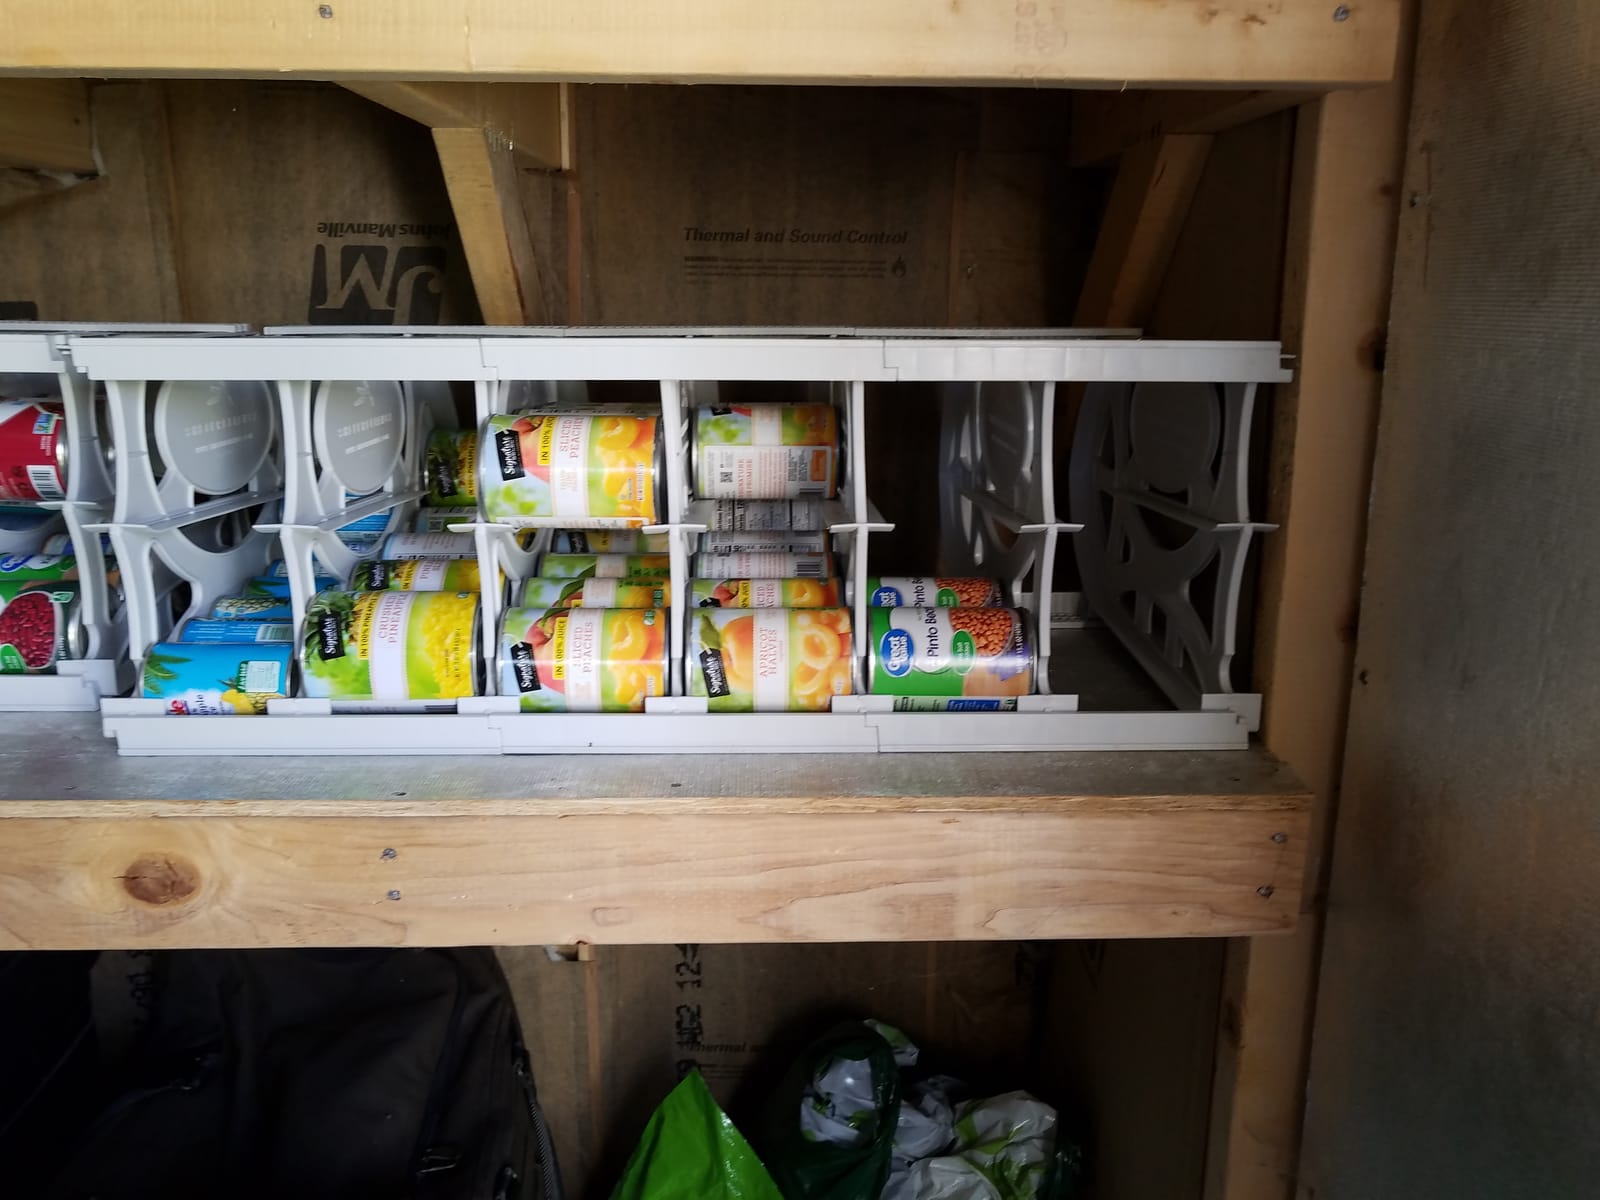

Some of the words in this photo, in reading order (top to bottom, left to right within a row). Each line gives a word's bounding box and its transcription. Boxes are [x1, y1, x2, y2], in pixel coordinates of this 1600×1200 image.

[317, 222, 396, 238] Manville
[685, 228, 750, 243] Thermal
[754, 230, 785, 243] and
[789, 229, 842, 244] Sound
[847, 230, 908, 245] Control
[501, 437, 517, 475] Signature
[322, 618, 340, 655] Signature
[556, 620, 566, 640] JUICE
[924, 627, 939, 656] Pinto
[760, 627, 768, 677] APRICOT
[768, 629, 777, 676] HALVES
[887, 636, 903, 671] Great
[897, 635, 910, 663] Value
[517, 650, 534, 688] Signature
[705, 657, 722, 694] Signature
